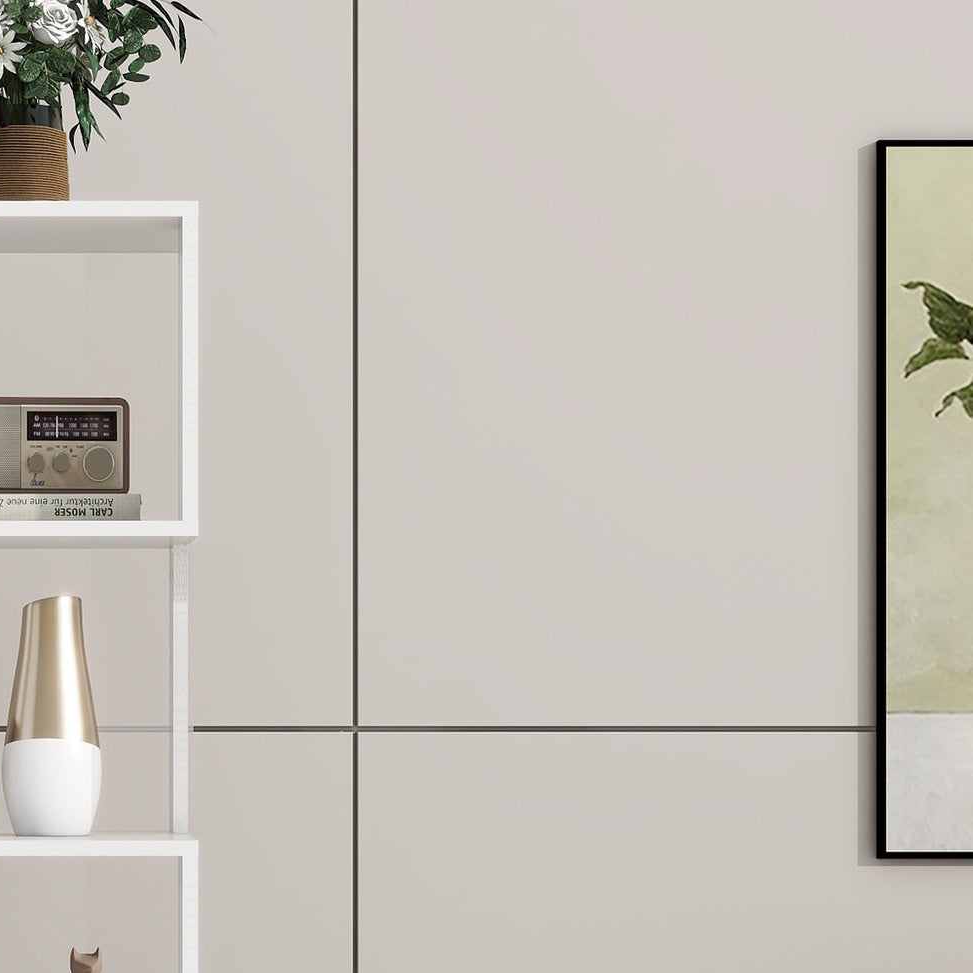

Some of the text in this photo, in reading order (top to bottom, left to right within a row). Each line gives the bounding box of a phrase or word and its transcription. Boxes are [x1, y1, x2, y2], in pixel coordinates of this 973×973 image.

[6, 498, 27, 506] neue
[29, 498, 48, 507] eine
[50, 498, 63, 507] für
[65, 498, 114, 507] Architektur
[54, 507, 114, 517] CARL MOSER
